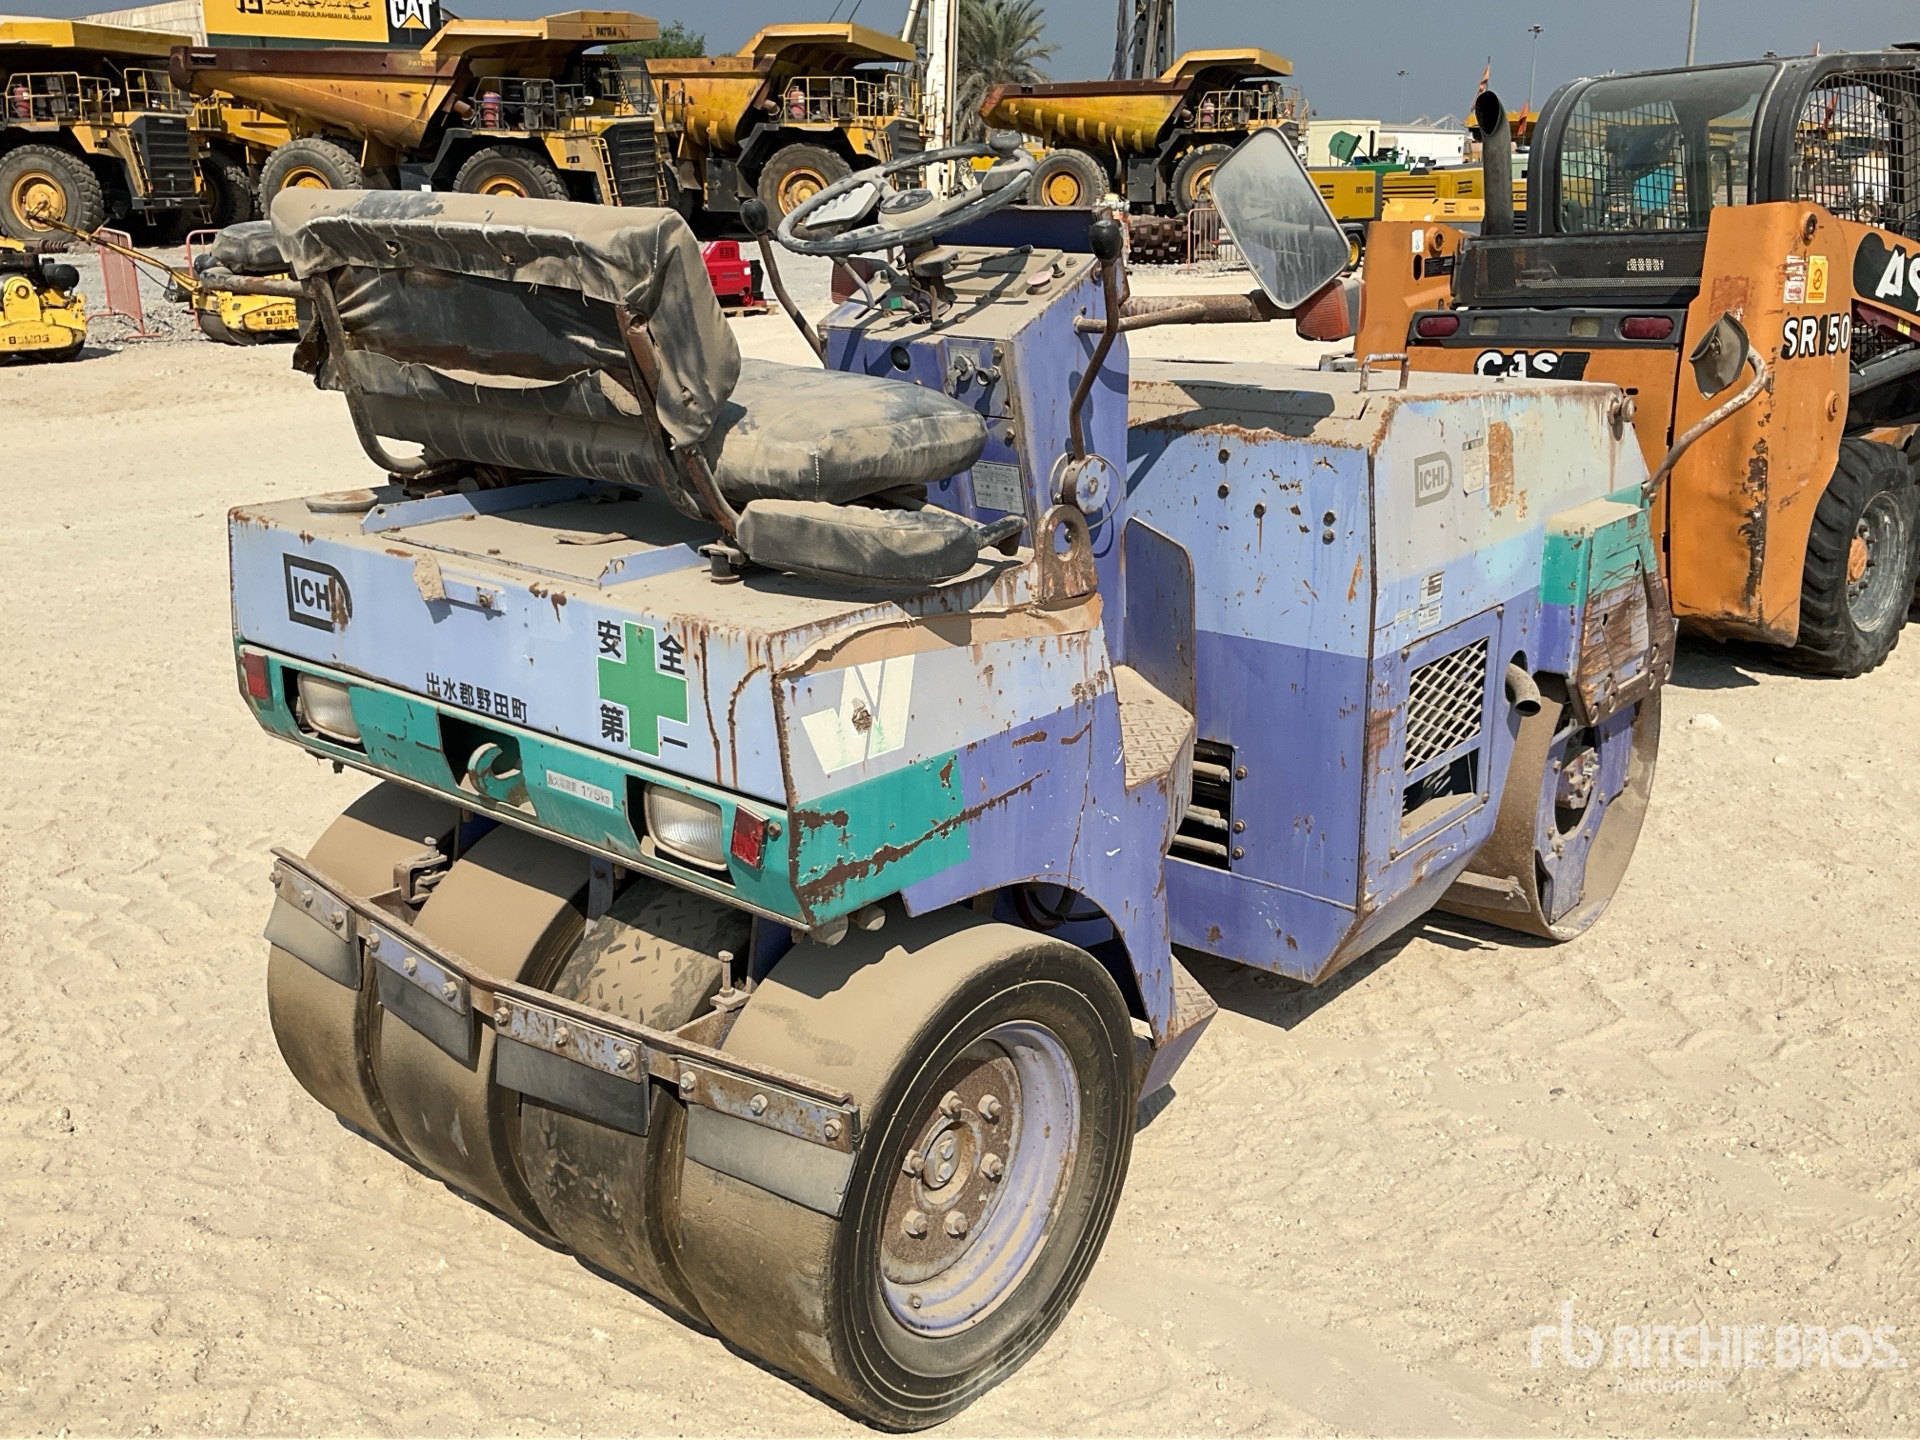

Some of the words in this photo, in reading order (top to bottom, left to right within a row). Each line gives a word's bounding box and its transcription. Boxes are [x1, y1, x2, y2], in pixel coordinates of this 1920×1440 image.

[265, 9, 296, 17] MOHAMED
[297, 11, 342, 19] ABDULRAHMAN
[390, 0, 433, 29] CAT
[266, 315, 297, 325] BOMA
[1782, 313, 1850, 359] SR150
[1474, 350, 1588, 381] CAS
[426, 672, 528, 724] 出水郡野田町
